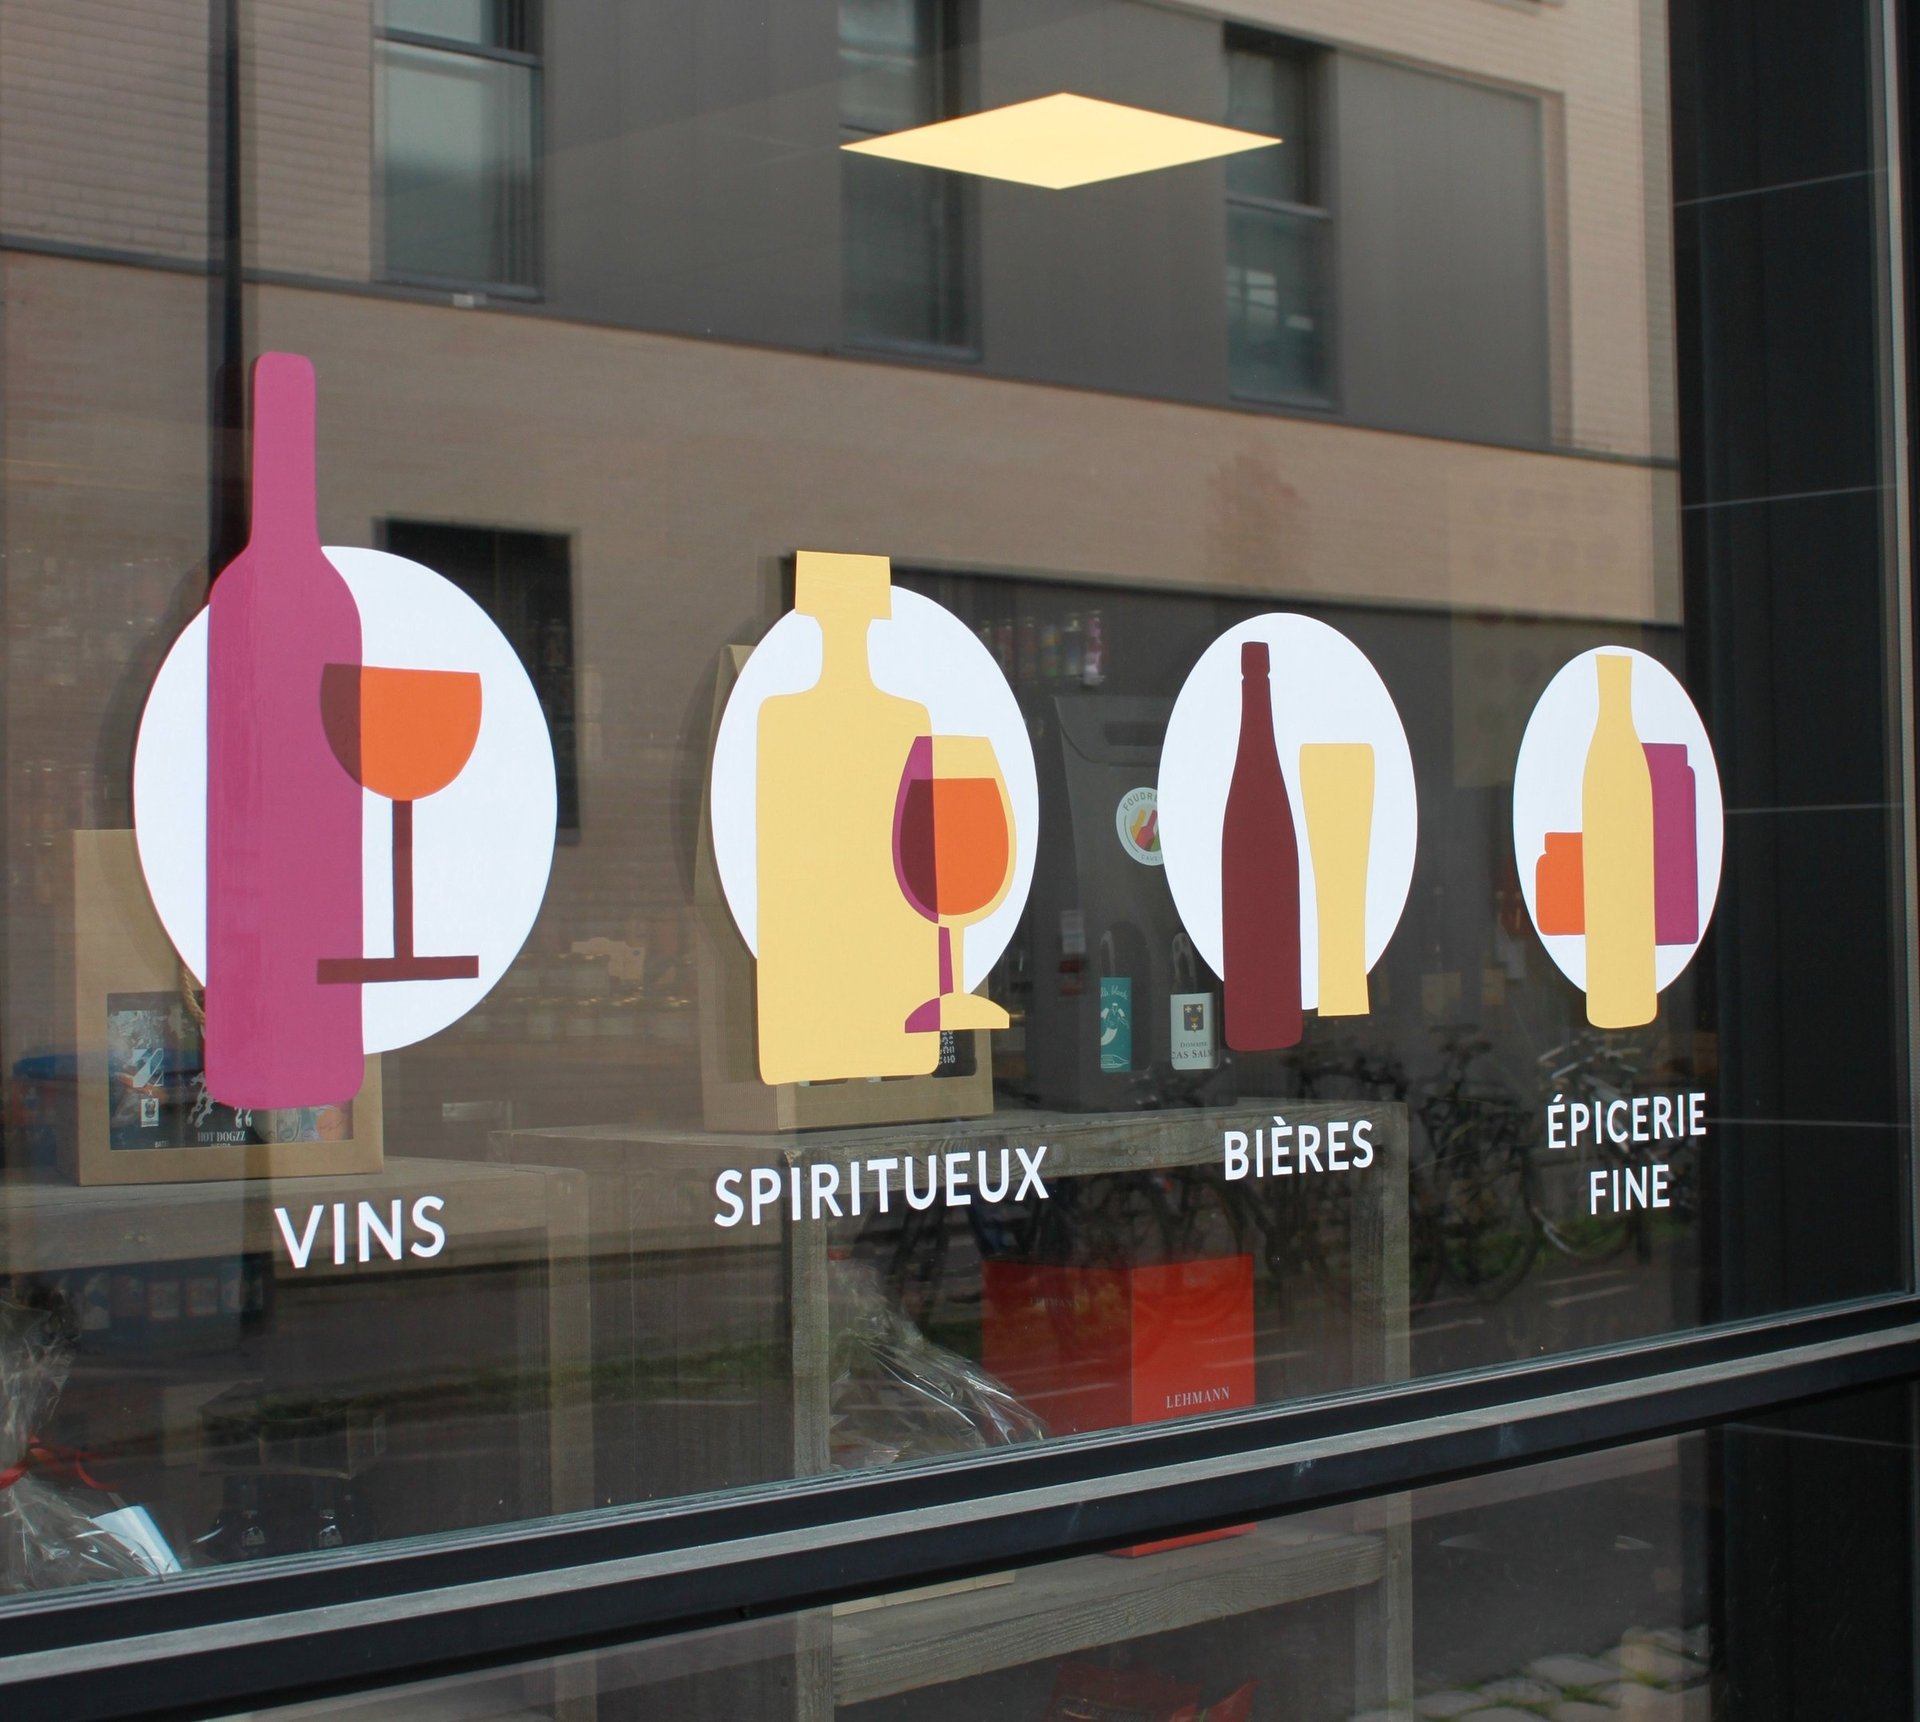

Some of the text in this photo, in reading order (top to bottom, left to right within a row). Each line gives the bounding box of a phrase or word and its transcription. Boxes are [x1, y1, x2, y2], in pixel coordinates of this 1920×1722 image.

[197, 1131, 214, 1142] HOT
[1224, 1116, 1374, 1181] BIÈRES
[1547, 1093, 1707, 1149] ÉPICERIE
[714, 1145, 1049, 1227] SPIRITUEUX
[1590, 1164, 1671, 1215] FINE
[274, 1195, 445, 1269] VINS
[1166, 1386, 1230, 1409] LEHMANN
